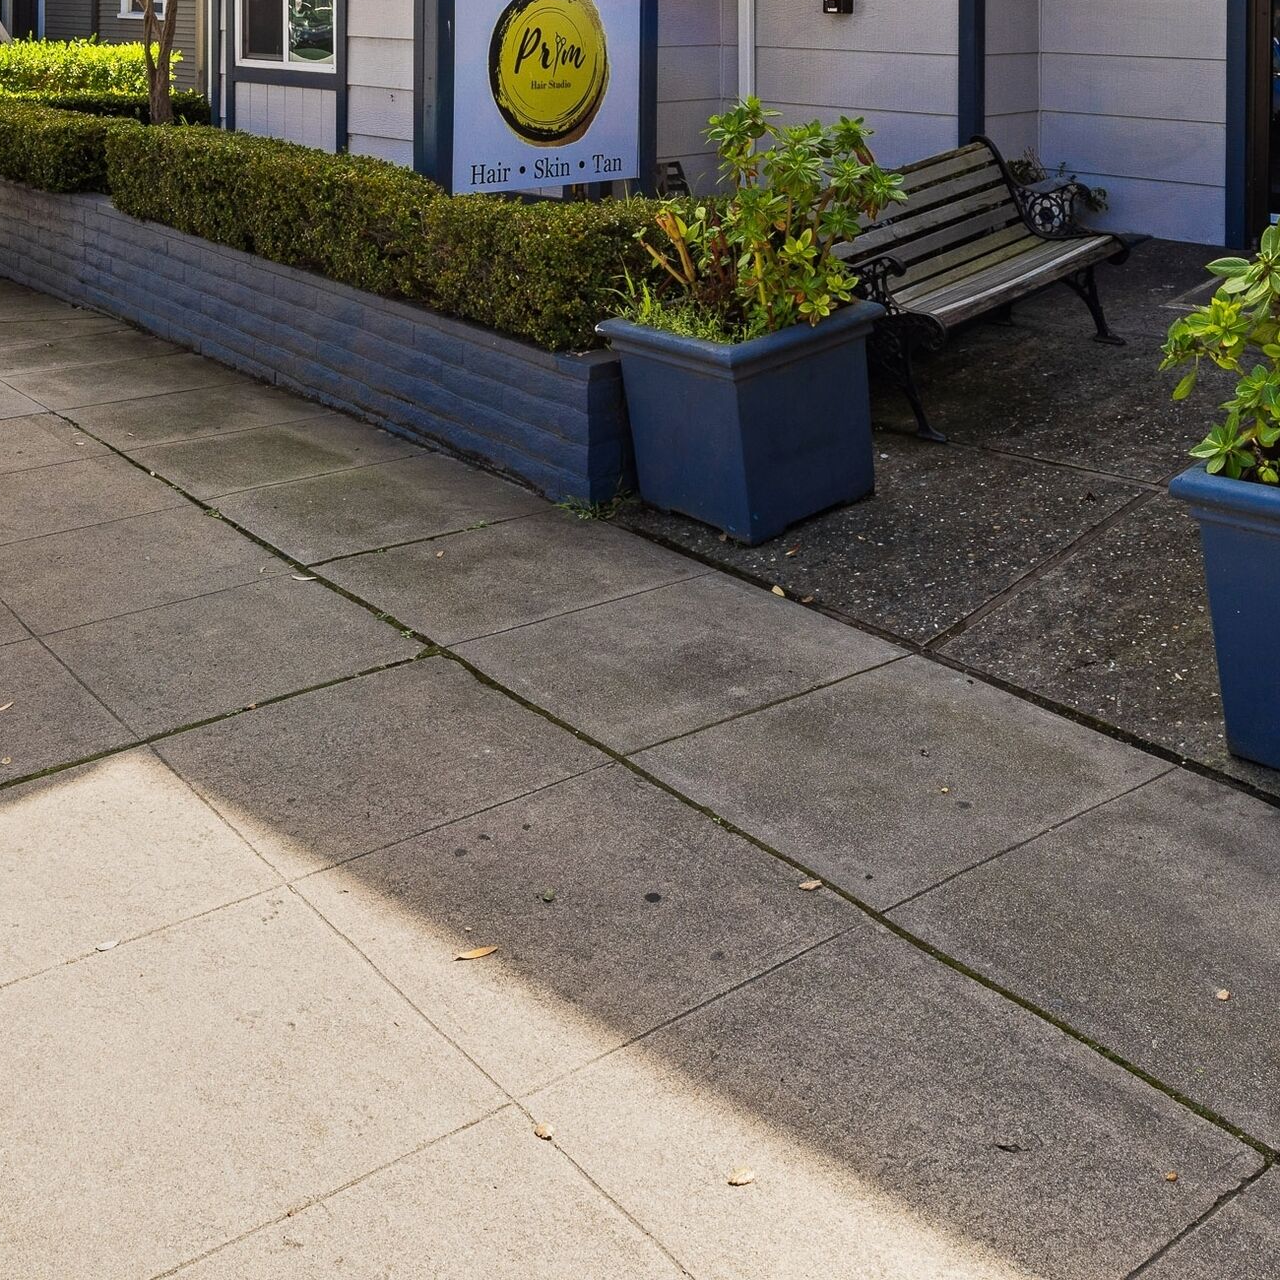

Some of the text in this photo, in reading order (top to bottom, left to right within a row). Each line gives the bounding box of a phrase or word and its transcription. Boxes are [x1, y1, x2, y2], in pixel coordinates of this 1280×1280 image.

[530, 78, 572, 90] Hair Studio
[470, 154, 622, 185] Hair Skin Tan
